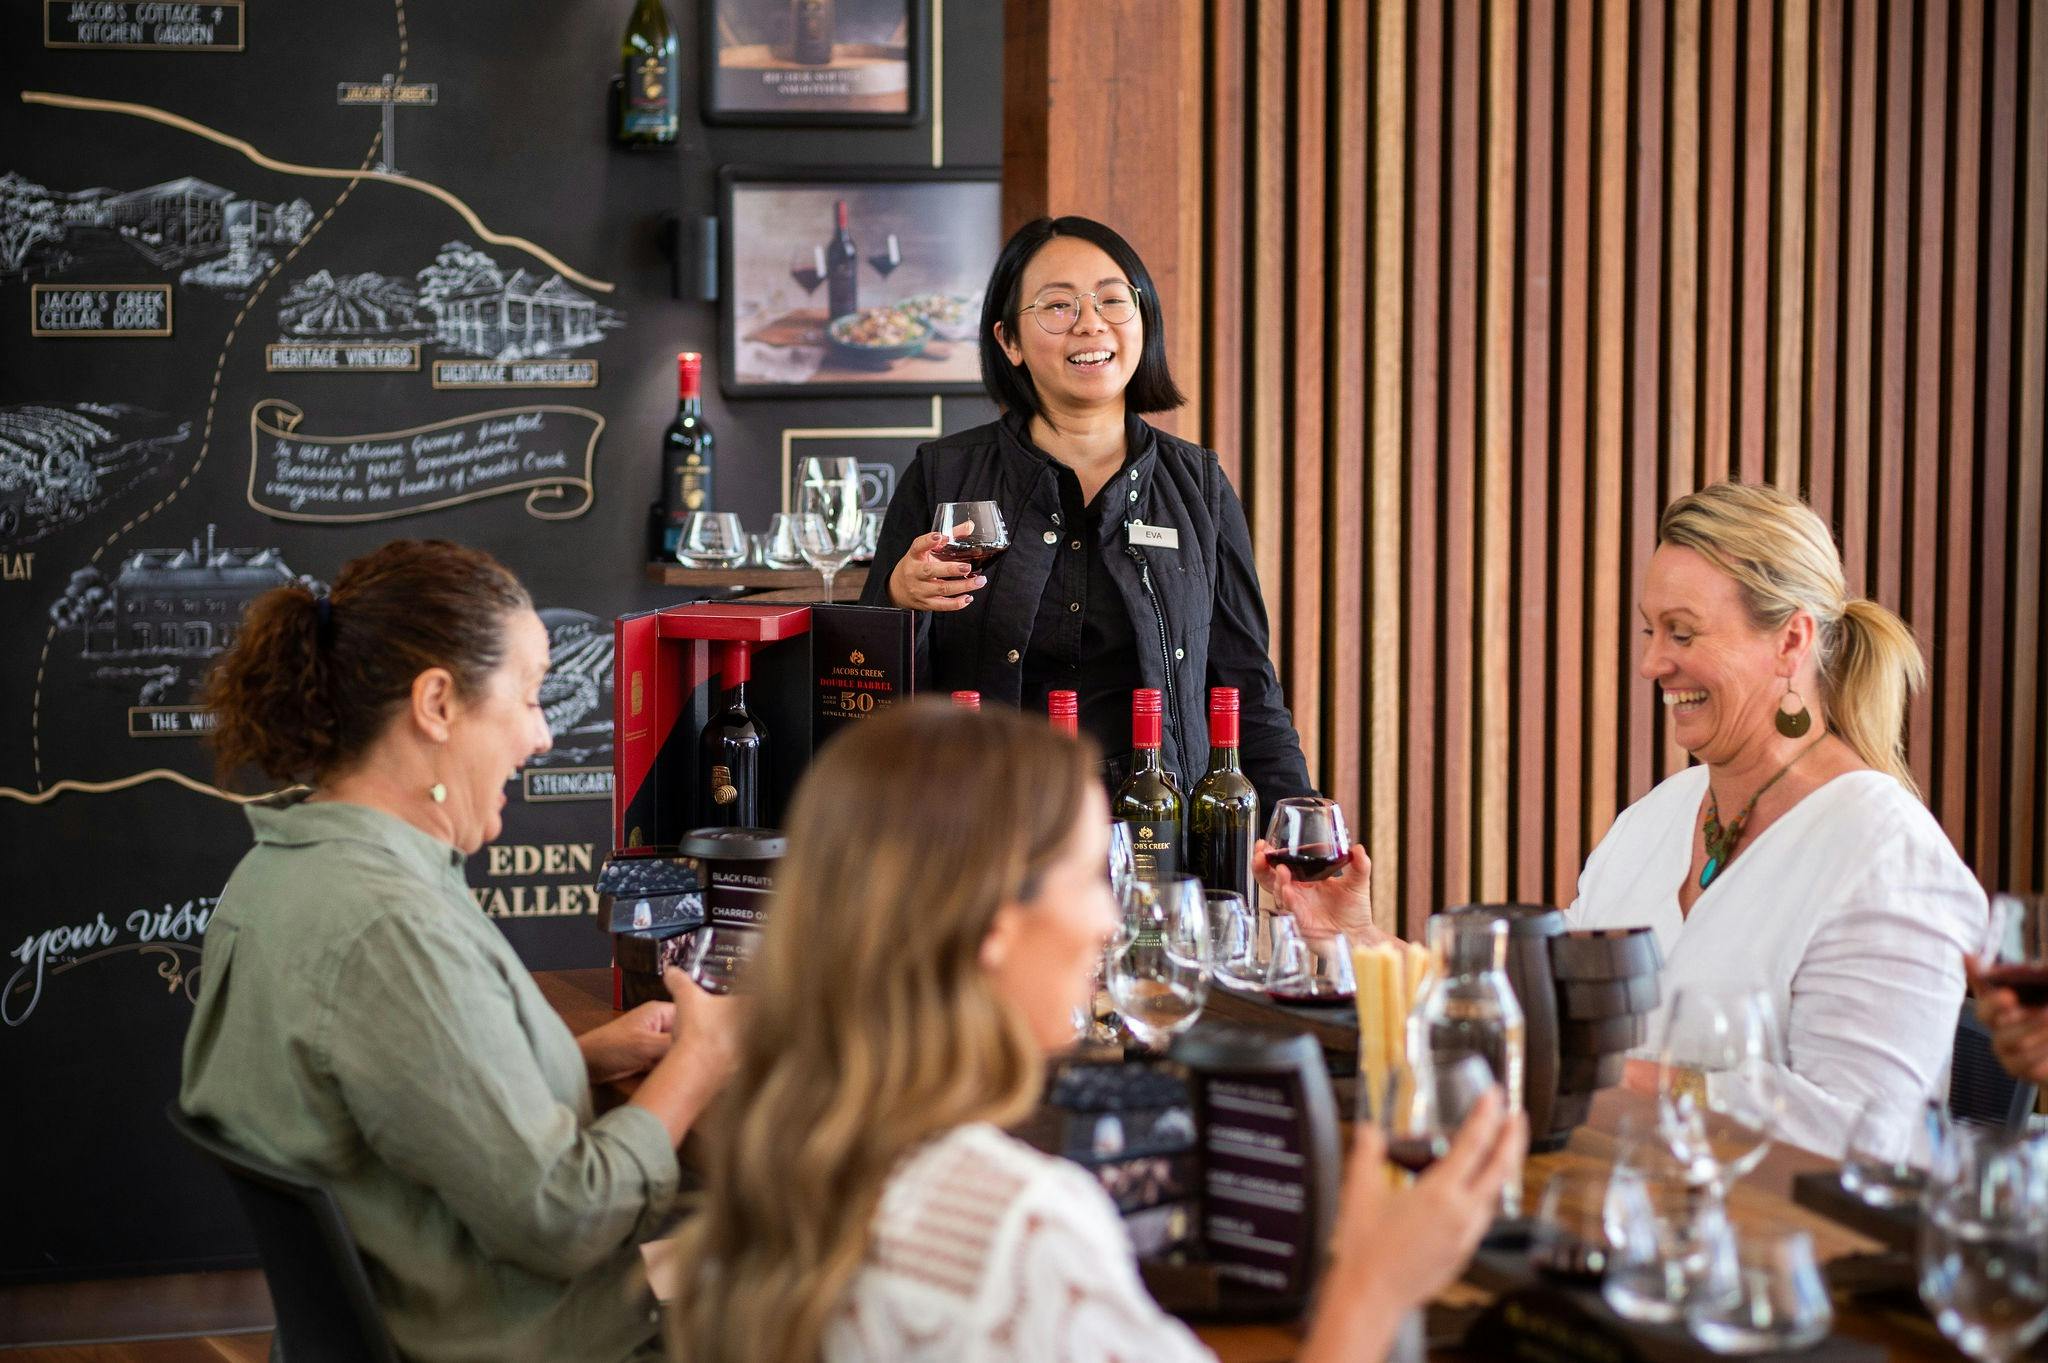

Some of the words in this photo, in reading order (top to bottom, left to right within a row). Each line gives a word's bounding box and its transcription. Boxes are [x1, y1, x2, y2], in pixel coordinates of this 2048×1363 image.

[136, 2, 200, 23] COTTAGE
[78, 22, 144, 43] KITCHEN
[154, 23, 214, 44] GARDEN
[40, 291, 109, 312] JACOB'S
[116, 291, 165, 312] CREEK
[40, 309, 104, 329] CELLAR
[113, 308, 160, 329] DOOR
[272, 348, 338, 367] HERITAGE
[345, 348, 412, 367] VINEYARD
[440, 364, 506, 382] HERITAGE
[820, 678, 855, 689] DOUBLE
[857, 681, 893, 691] BARREL
[841, 691, 873, 712] 50
[150, 712, 179, 731] THE
[487, 843, 594, 877] EDEN
[712, 872, 741, 883] BLACK
[743, 875, 773, 887] FRUITS
[712, 907, 753, 920] CHARRED
[755, 911, 769, 921] OA
[2, 911, 118, 1027] your
